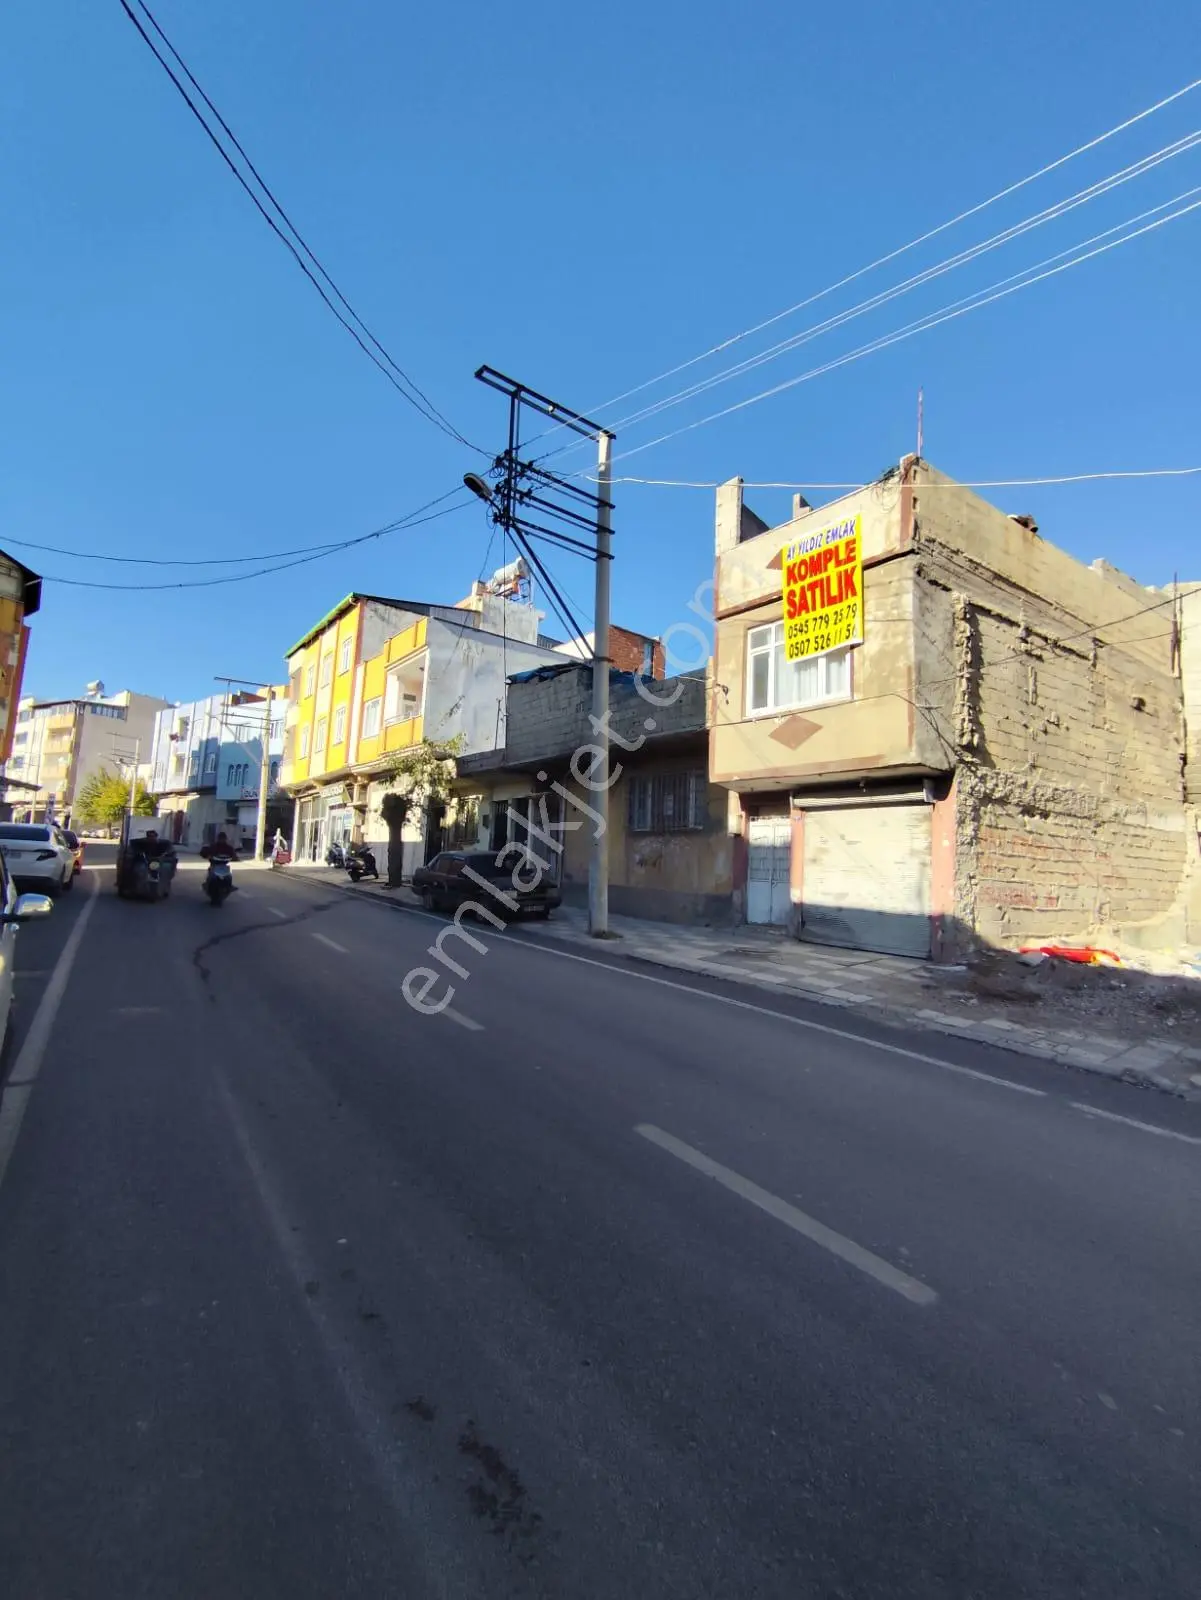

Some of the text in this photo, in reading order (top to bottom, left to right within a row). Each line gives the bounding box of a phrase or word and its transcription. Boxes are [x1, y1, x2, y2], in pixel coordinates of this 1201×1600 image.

[787, 519, 856, 560] AY YILDIZ EMLAK
[787, 538, 857, 586] KOMPLE
[787, 565, 857, 619] SATILIK
[788, 603, 857, 639] 0545 779 25 79
[789, 638, 810, 658] 0507
[814, 632, 831, 651] 526
[834, 627, 842, 645] 11
